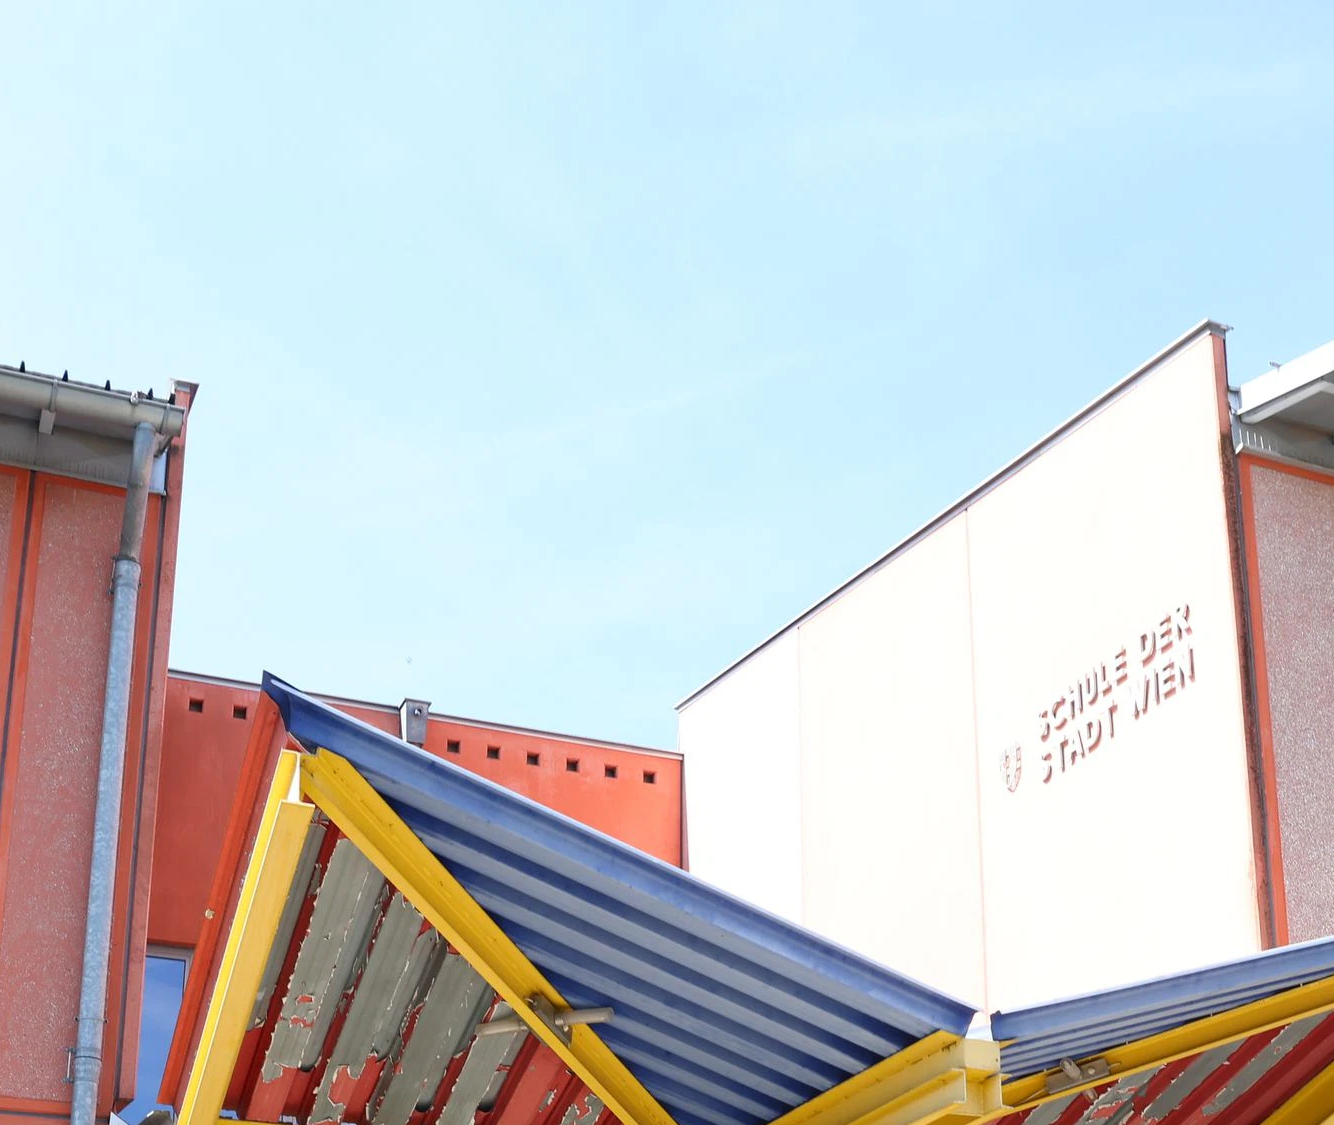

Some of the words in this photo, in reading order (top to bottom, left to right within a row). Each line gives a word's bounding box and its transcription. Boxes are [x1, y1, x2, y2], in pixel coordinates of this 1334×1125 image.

[1038, 645, 1128, 743] SCHULE
[1140, 603, 1193, 668] DER
[1040, 700, 1118, 784] STADT
[1129, 644, 1196, 720] WIEN
